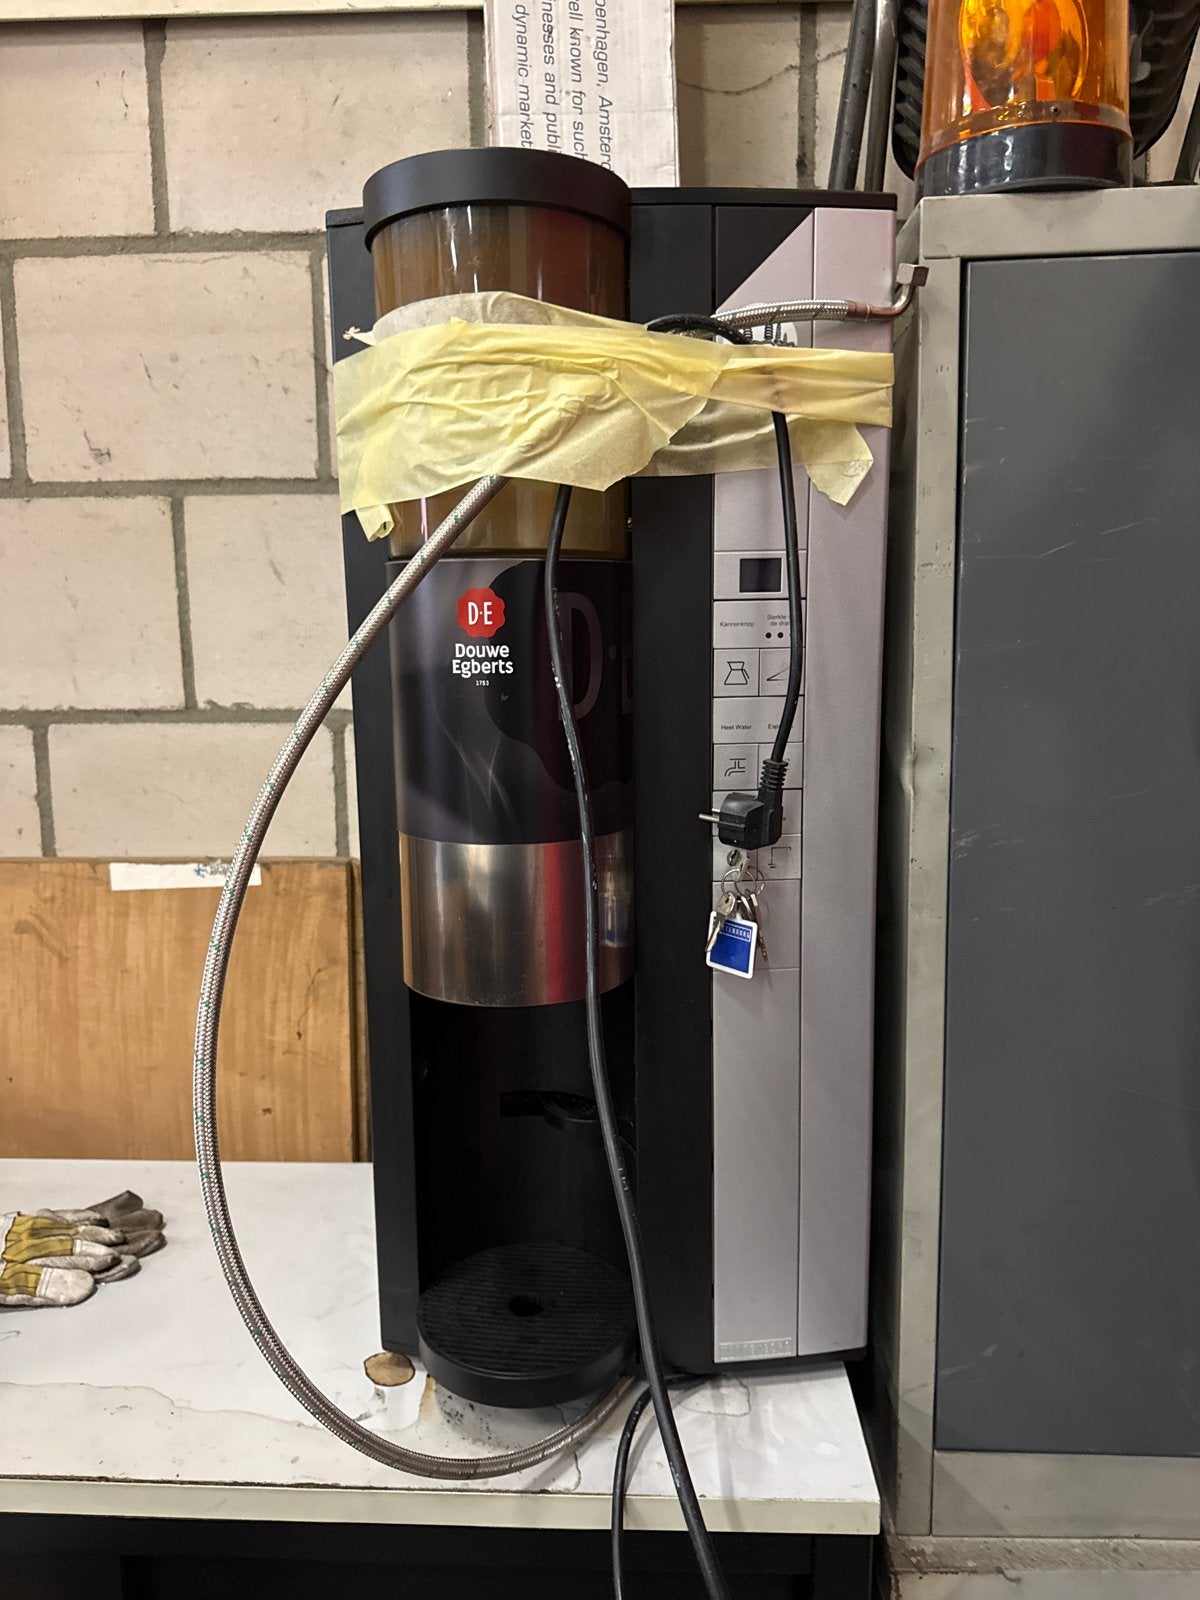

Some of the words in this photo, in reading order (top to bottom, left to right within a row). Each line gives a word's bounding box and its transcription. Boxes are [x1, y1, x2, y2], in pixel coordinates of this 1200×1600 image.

[569, 0, 584, 21] ell
[512, 4, 533, 78] dynamic
[569, 27, 584, 83] known
[544, 72, 560, 106] and
[572, 90, 587, 115] for
[519, 84, 535, 148] market
[455, 643, 510, 658] Douwe
[452, 659, 514, 678] Egberts
